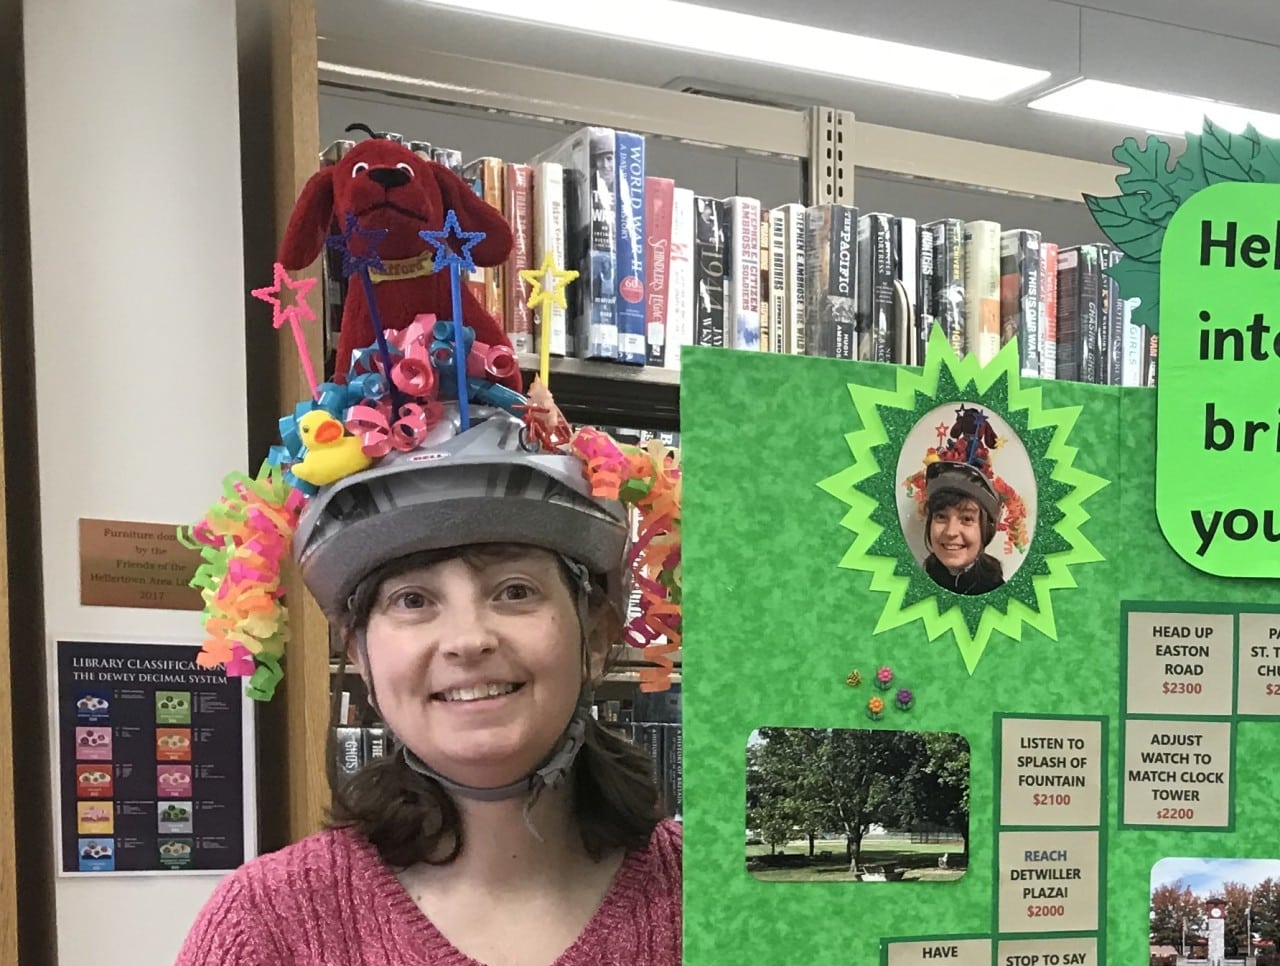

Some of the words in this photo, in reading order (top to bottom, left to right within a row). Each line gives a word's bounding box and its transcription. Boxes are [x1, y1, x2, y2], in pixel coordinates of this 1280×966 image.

[628, 146, 643, 209] WORLD
[741, 202, 750, 257] AMBROSE
[796, 211, 805, 251] STEPHEN
[838, 230, 851, 295] PACIFIC
[741, 264, 750, 311] SOLDIERS
[749, 264, 758, 313] CITIZEN
[796, 261, 805, 305] AMBROSE
[1027, 270, 1037, 296] THIS
[1026, 309, 1037, 333] OUR
[1087, 301, 1097, 350] CHASING
[1026, 335, 1037, 360] WAR
[1128, 326, 1138, 365] GIRLS
[1086, 352, 1096, 383] GHOS
[104, 528, 154, 540] Furniture
[136, 545, 146, 556] by
[151, 545, 167, 554] the
[116, 560, 155, 569] Friends
[158, 562, 169, 570] of
[171, 563, 187, 572] the
[91, 573, 146, 584] Hellertown
[150, 577, 173, 586] Area
[140, 591, 165, 600] 2017
[1153, 626, 1190, 638] HEAD
[1195, 627, 1213, 638] UP
[1156, 645, 1209, 657] EASTON
[73, 657, 124, 668] LIBRARY
[1165, 664, 1203, 675] ROAD
[73, 672, 97, 681] THE
[99, 672, 136, 682] DEWEY
[138, 673, 187, 683] DECIMAL
[189, 674, 227, 685] SYSTEM
[1163, 682, 1201, 694] $2300
[371, 738, 383, 758] THE
[1021, 738, 1063, 749] LISTEN
[1067, 739, 1084, 749] TO
[345, 741, 358, 769] GHOS
[1018, 756, 1066, 768] SPLASH
[1071, 758, 1086, 768] OF
[1019, 775, 1085, 787] FOUNTAIN
[1033, 794, 1070, 806] $2100
[1025, 851, 1066, 861] REACH
[1011, 869, 1081, 880] DETWILLER
[1028, 905, 1064, 917] $2000
[923, 946, 958, 958] HAVE
